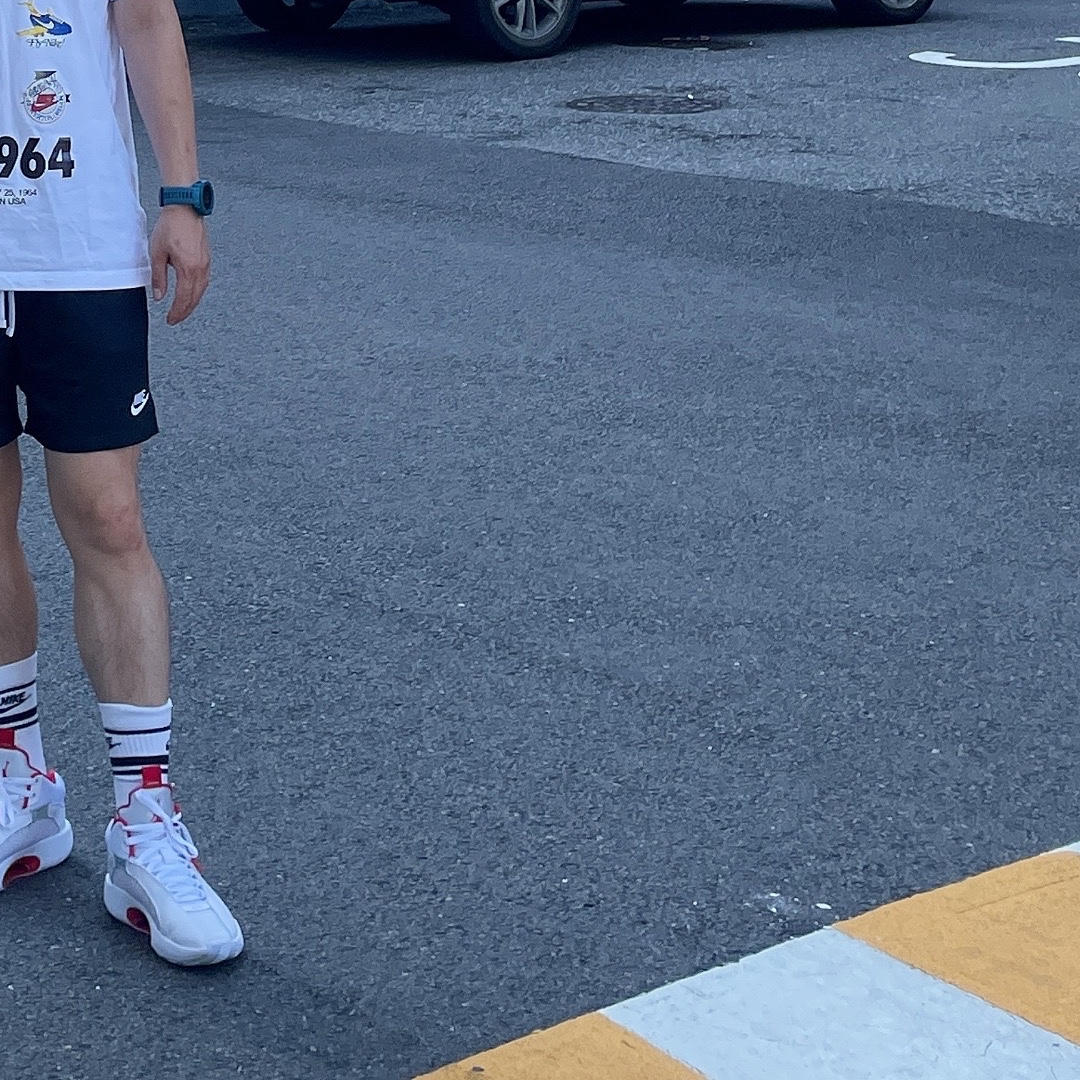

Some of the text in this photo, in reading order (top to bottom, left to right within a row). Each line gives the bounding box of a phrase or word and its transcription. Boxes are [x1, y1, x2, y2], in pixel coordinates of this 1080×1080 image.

[19, 188, 38, 196] 1964
[7, 197, 27, 205] USA
[0, 691, 26, 706] NIKE
